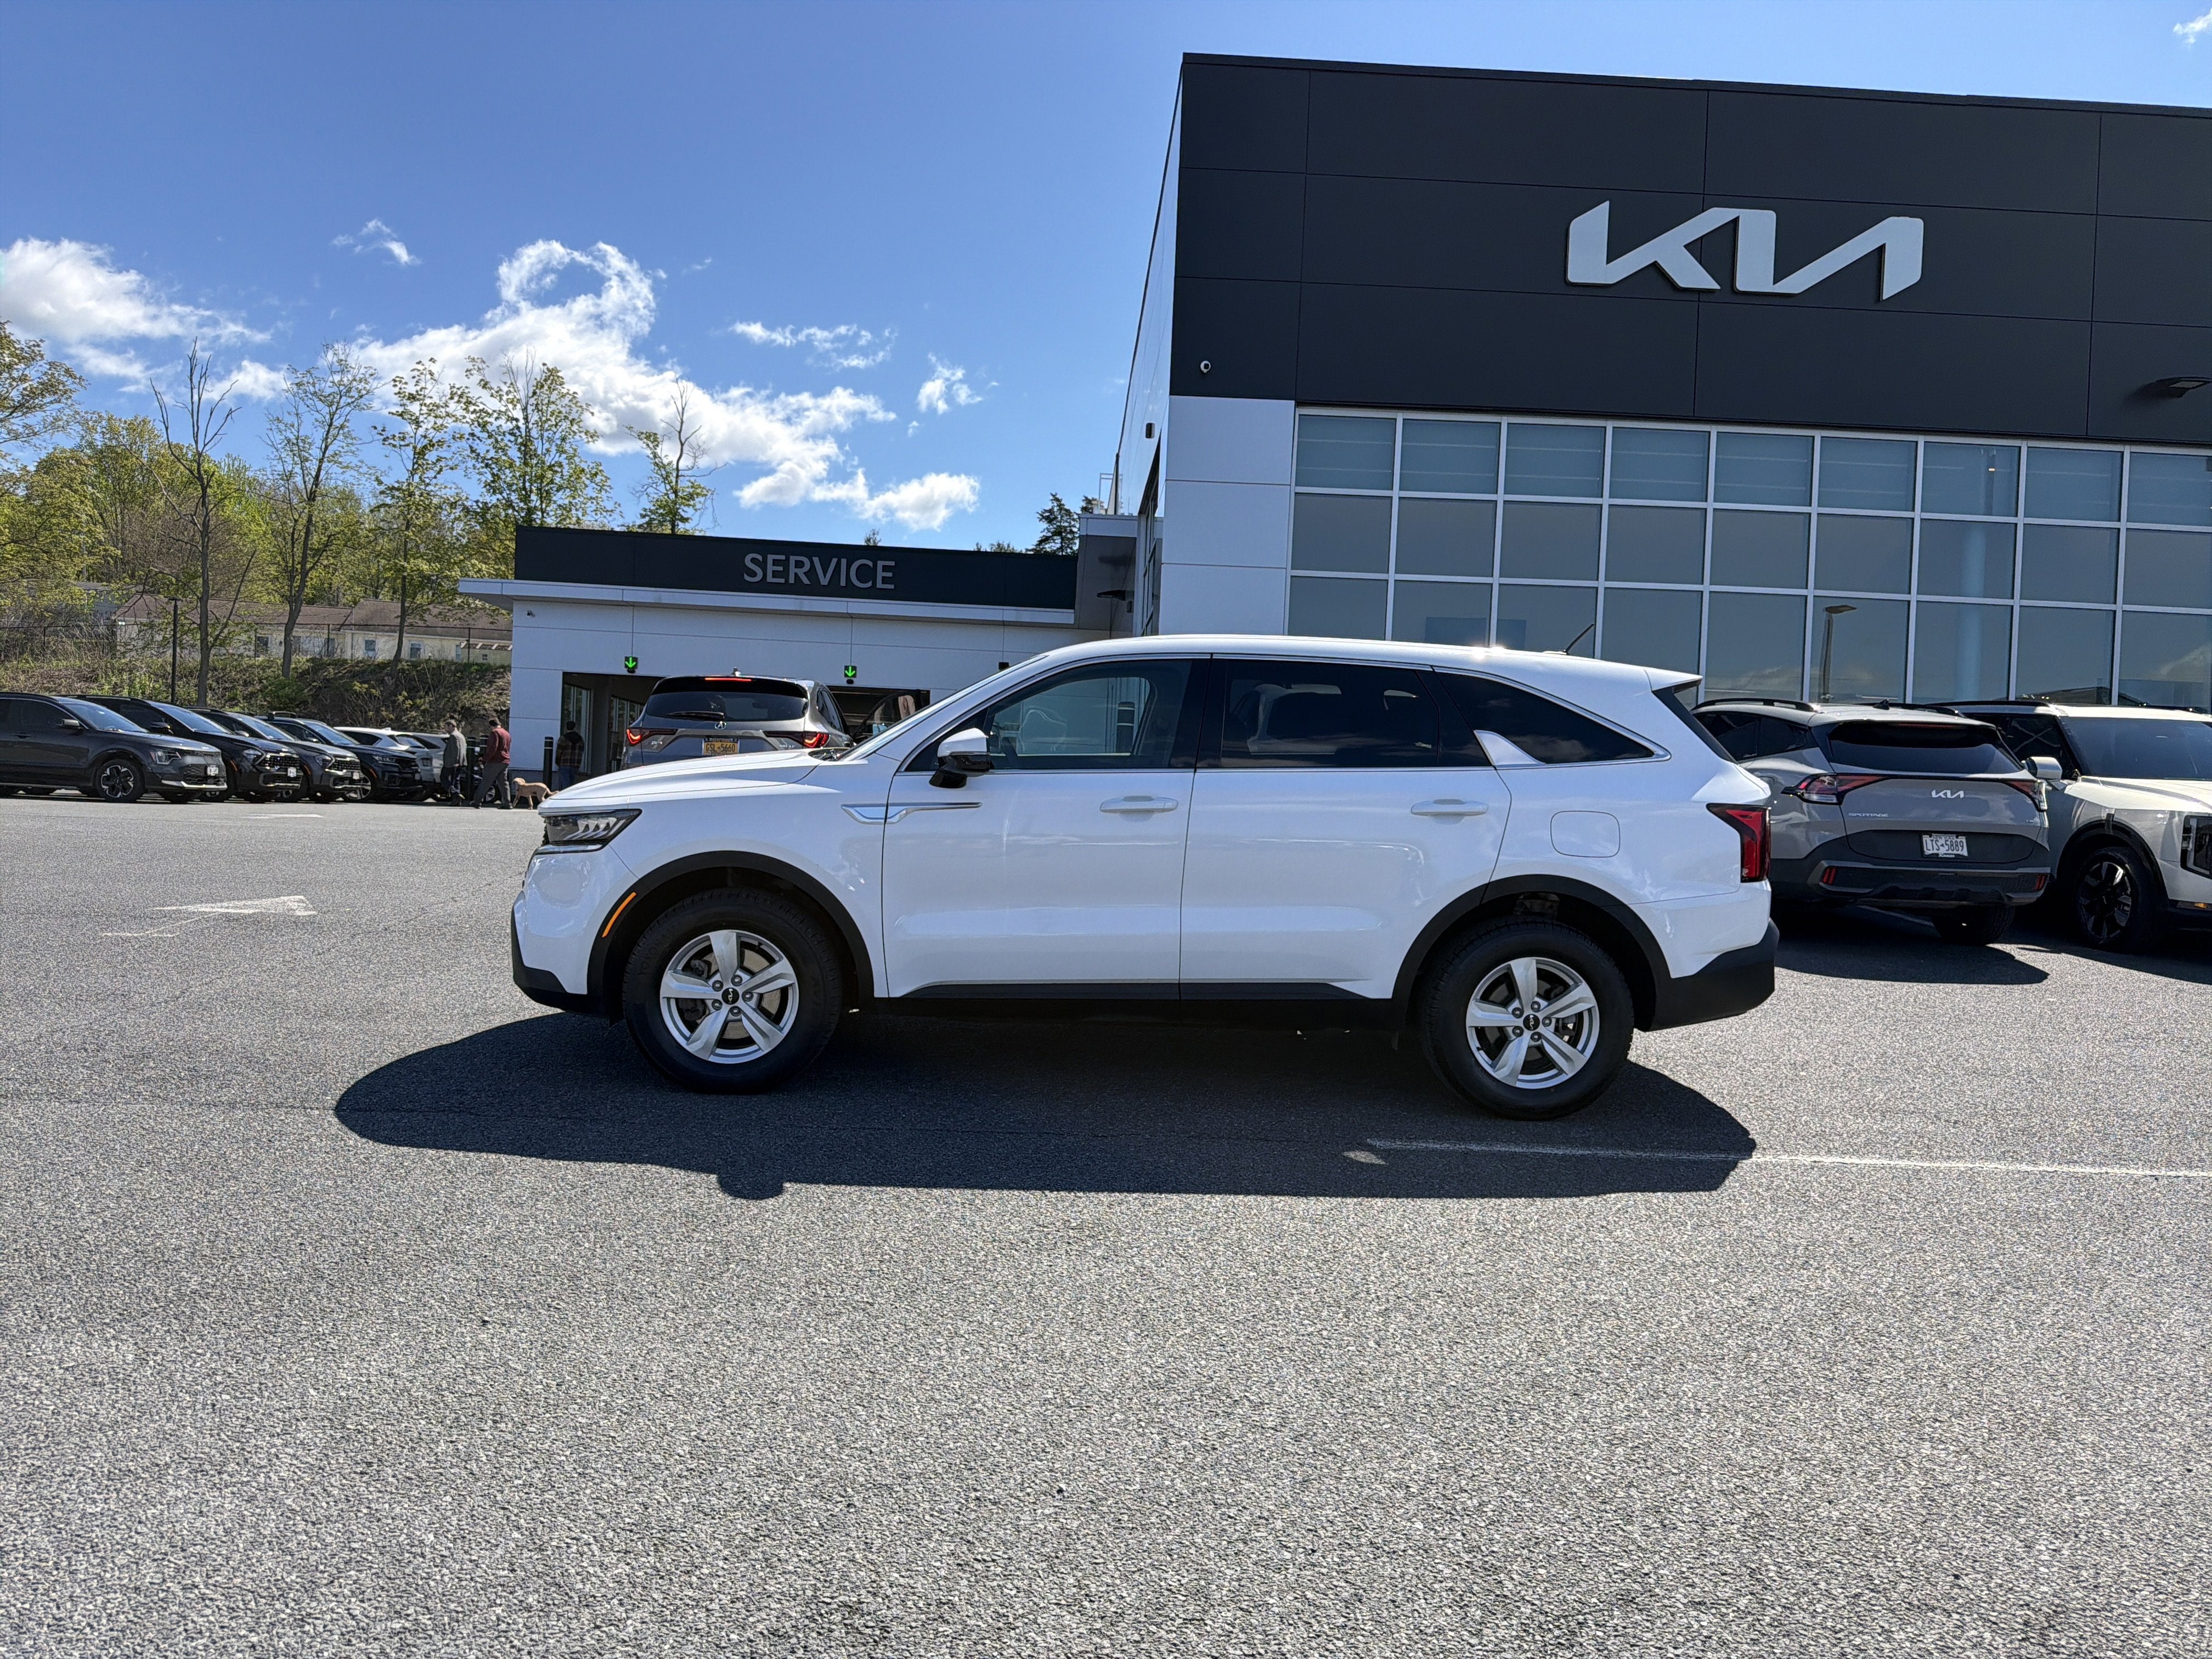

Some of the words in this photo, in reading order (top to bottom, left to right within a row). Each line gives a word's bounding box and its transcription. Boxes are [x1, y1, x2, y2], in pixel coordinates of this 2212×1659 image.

[1566, 200, 1924, 301] KIA
[743, 553, 895, 589] SERVICE
[1931, 789, 1964, 799] KIA
